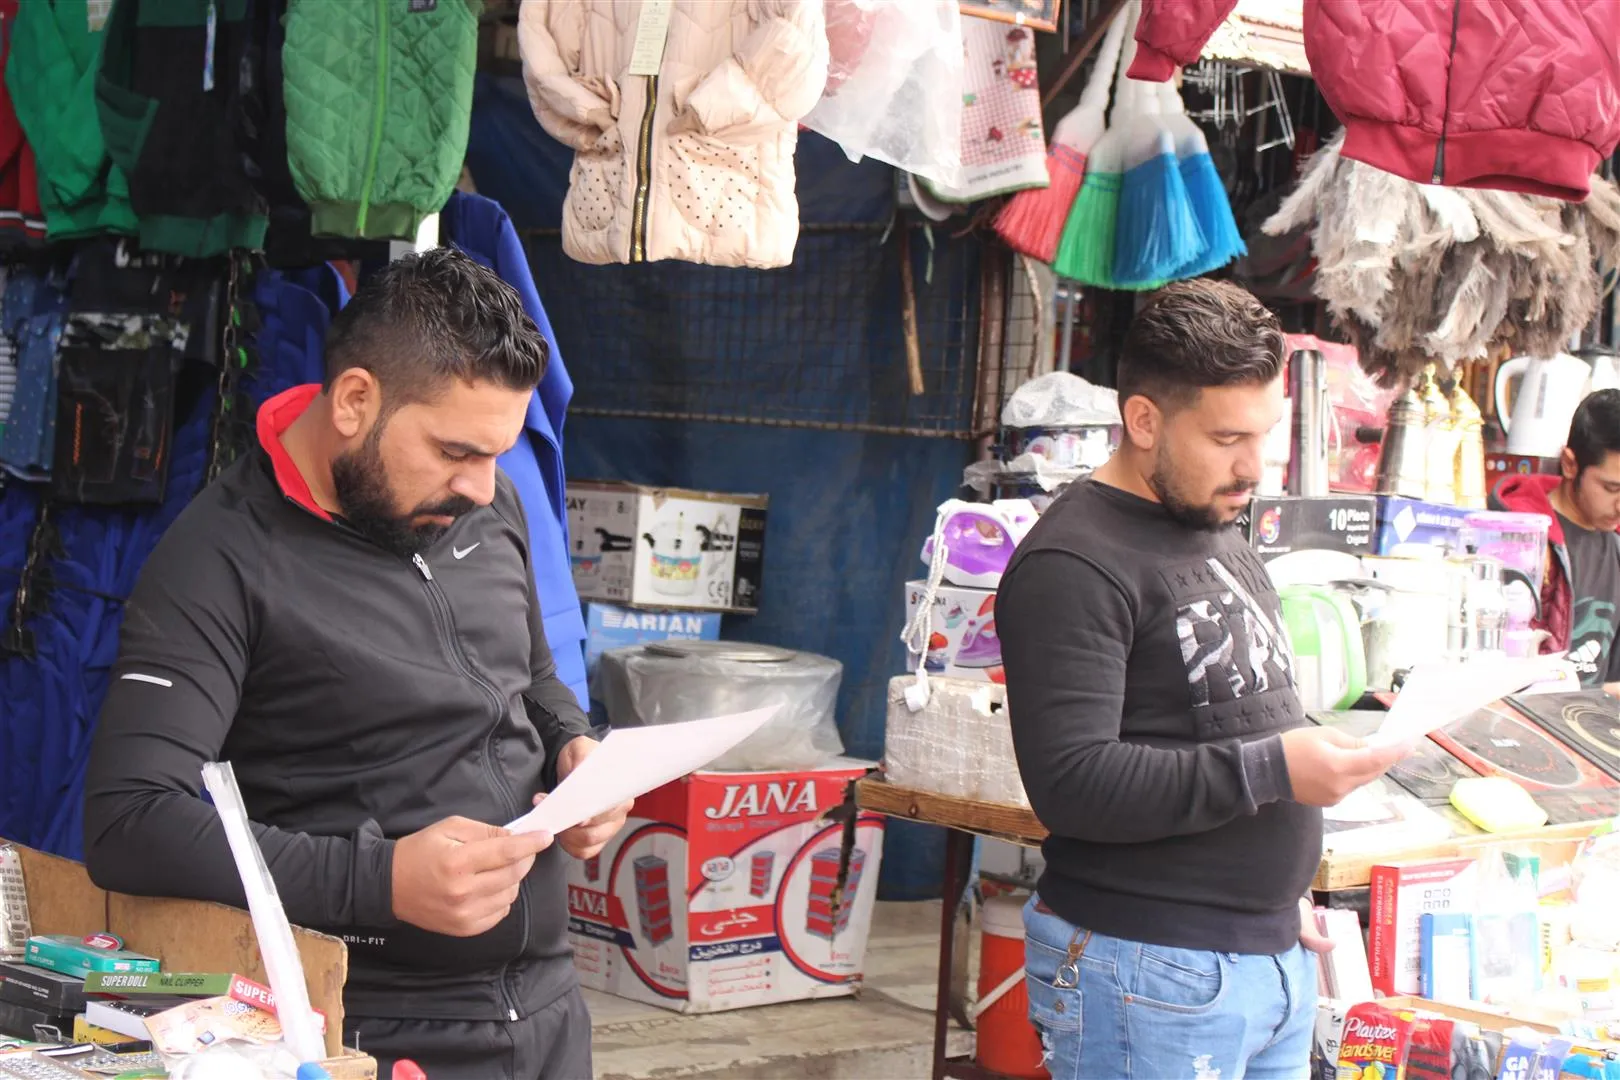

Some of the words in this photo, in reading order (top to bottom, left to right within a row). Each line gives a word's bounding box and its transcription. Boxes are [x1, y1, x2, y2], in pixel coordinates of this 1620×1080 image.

[1328, 508, 1347, 531] 10
[622, 612, 702, 634] ARIAN
[704, 779, 818, 820] JANA
[569, 889, 609, 917] ANA
[343, 935, 385, 946] DRI-FIT
[1373, 926, 1382, 977] CALCULATOR
[1344, 1017, 1398, 1043] Playtex
